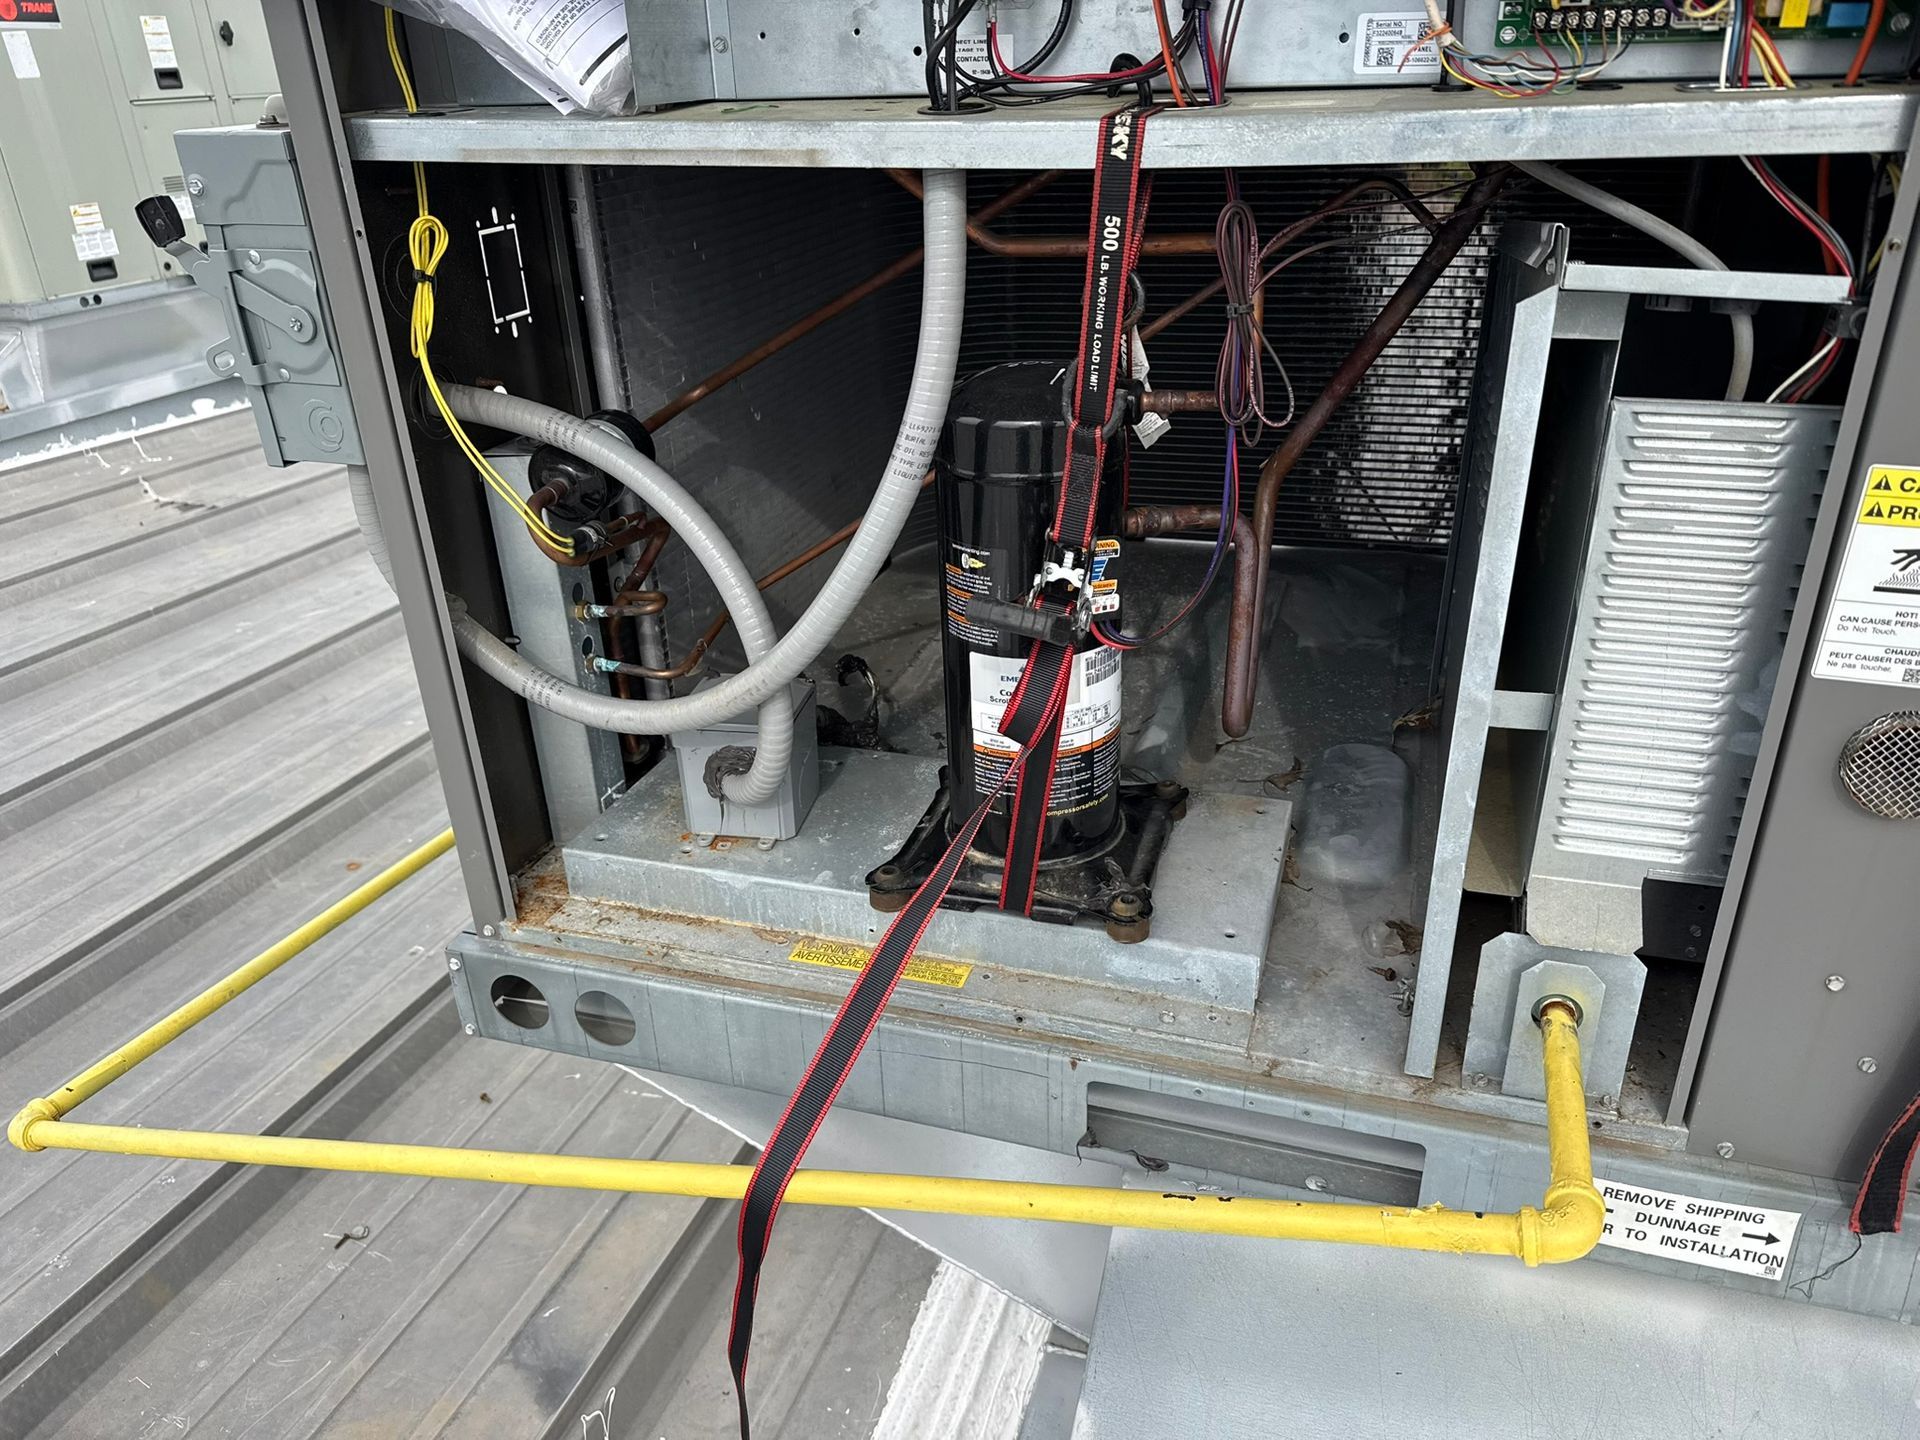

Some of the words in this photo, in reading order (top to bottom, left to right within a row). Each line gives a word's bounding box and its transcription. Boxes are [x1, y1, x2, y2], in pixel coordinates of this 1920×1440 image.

[21, 2, 53, 13] TRANE
[1102, 215, 1120, 251] 500
[1101, 255, 1110, 274] LB.
[1095, 276, 1108, 329] WORKING
[1091, 334, 1102, 363] LOAD
[1089, 366, 1099, 392] LIMIT
[904, 447, 915, 455] OIL
[900, 458, 915, 468] TYPE
[1887, 505, 1920, 520] PR
[1839, 615, 1859, 623] CAN
[1861, 617, 1893, 626] CAUSE
[1895, 611, 1918, 619] HOT!
[1872, 627, 1897, 636] Touch.
[1829, 651, 1853, 660] PEUT
[1855, 654, 1892, 663] CAUSER
[1894, 657, 1913, 666] DES
[1841, 662, 1857, 670] pas
[793, 950, 869, 969] AVERTISSEMEN
[1603, 1186, 1676, 1211] REMOVE
[1685, 1203, 1765, 1225] SHIPPING
[1635, 1212, 1721, 1237] DUNNAGE
[1625, 1227, 1647, 1241] TO
[1659, 1235, 1784, 1268] INSTALLATION
